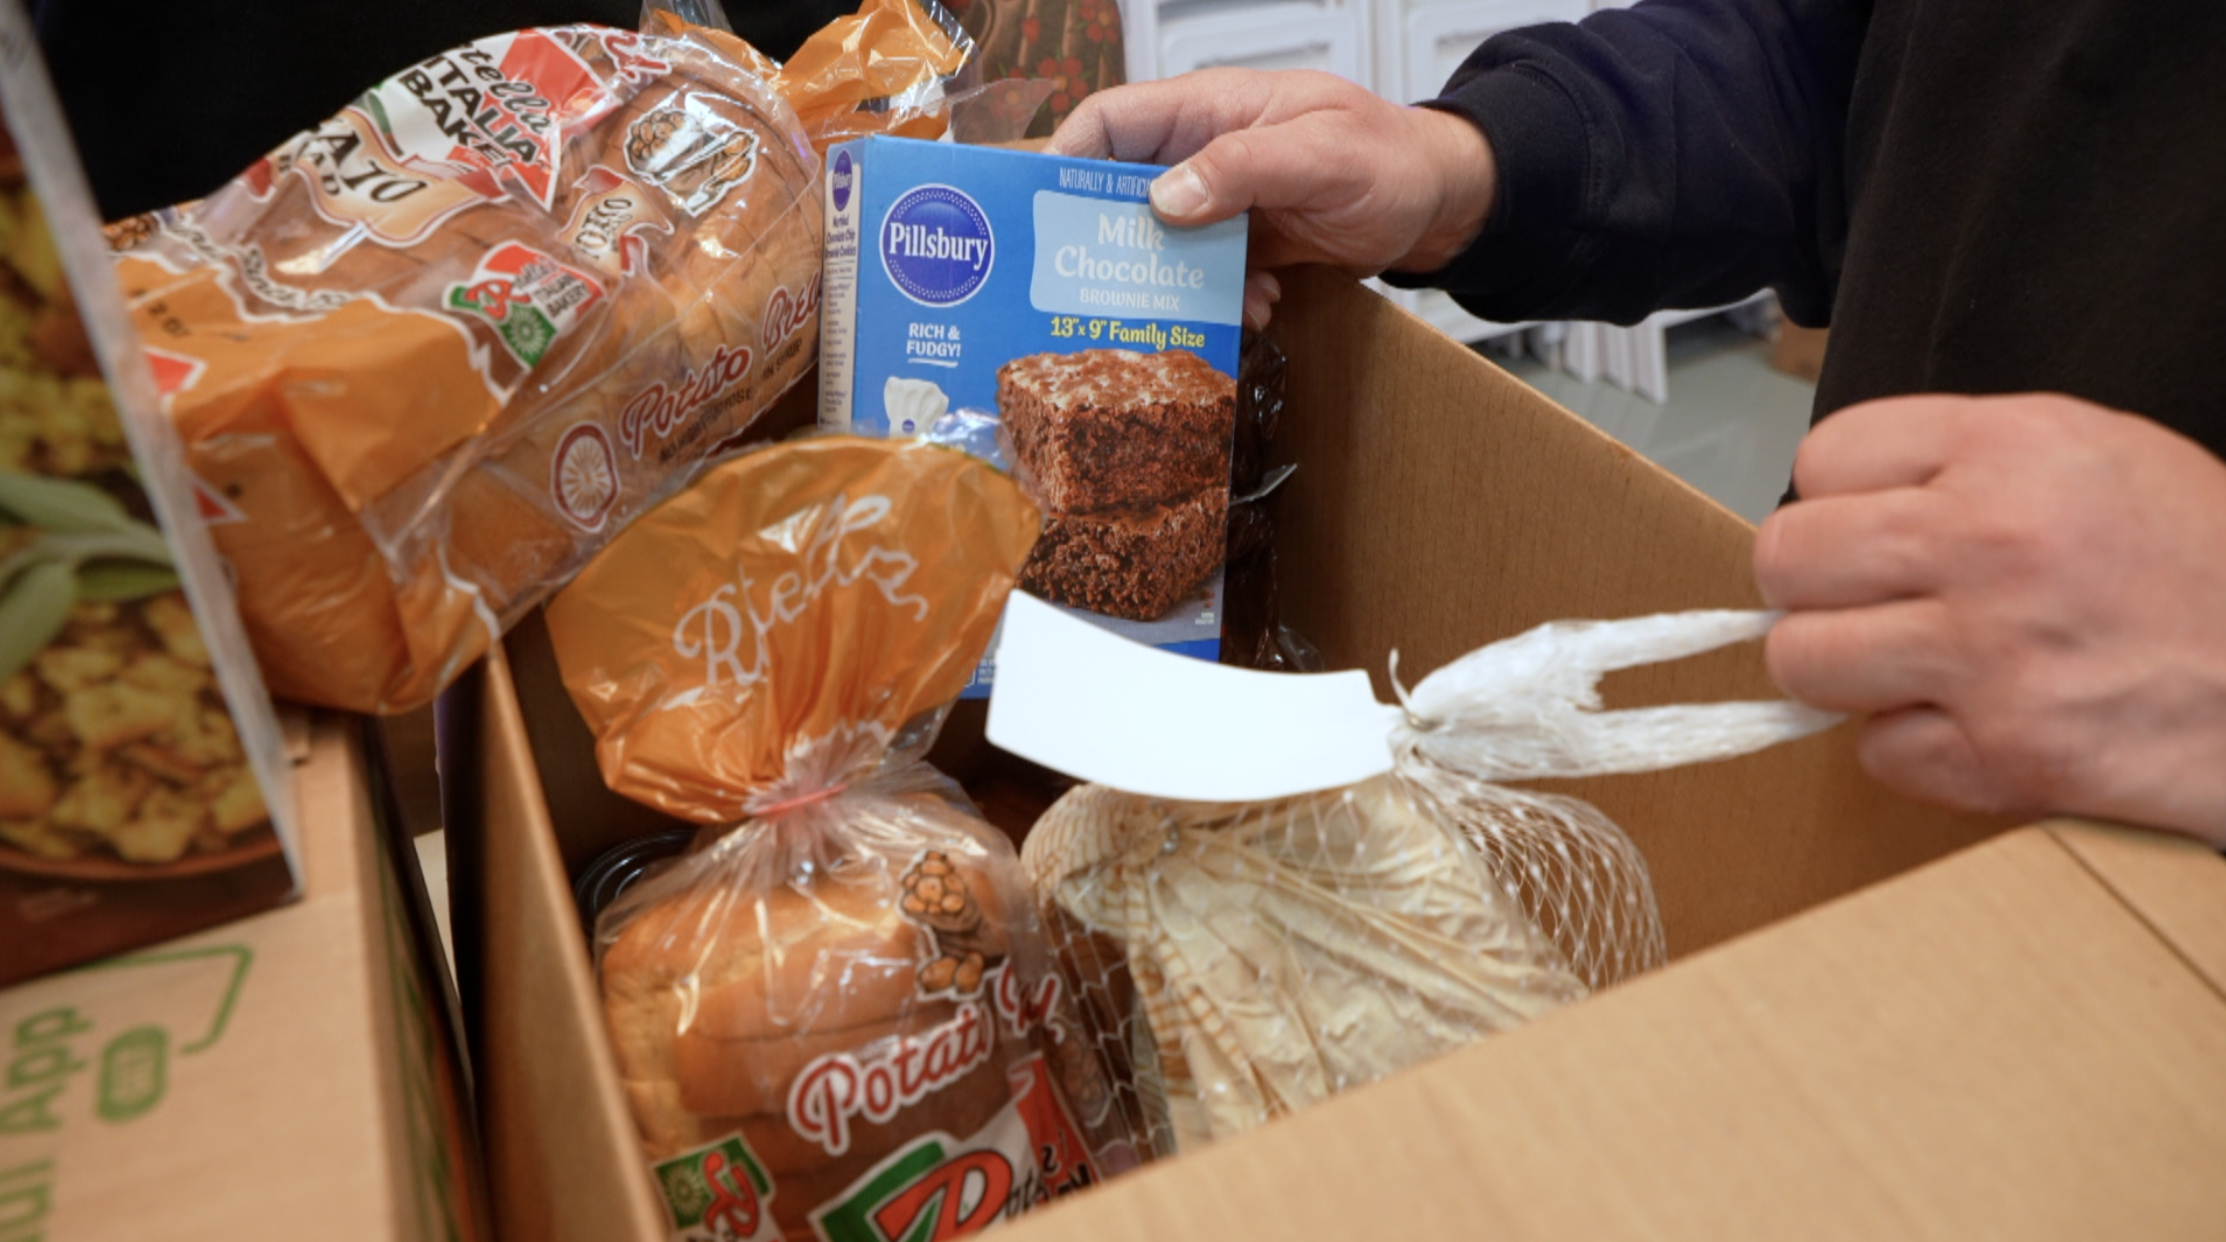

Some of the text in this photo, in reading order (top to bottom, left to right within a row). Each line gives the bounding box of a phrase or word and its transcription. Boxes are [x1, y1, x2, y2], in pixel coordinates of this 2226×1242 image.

[399, 68, 513, 166] BAKE
[423, 56, 539, 163] ITALIA
[1059, 167, 1104, 193] NATURALLY
[1106, 173, 1113, 194] &
[889, 222, 989, 272] Pillsbury
[1098, 213, 1165, 251] Milk
[1054, 244, 1205, 290] Chocolate
[1080, 288, 1180, 311] BROWNIE MIX
[906, 340, 962, 358] FUDGY!
[908, 322, 961, 341] RICH &
[1109, 320, 1167, 350] Family
[1170, 325, 1205, 348] Size
[619, 344, 752, 460] Potato
